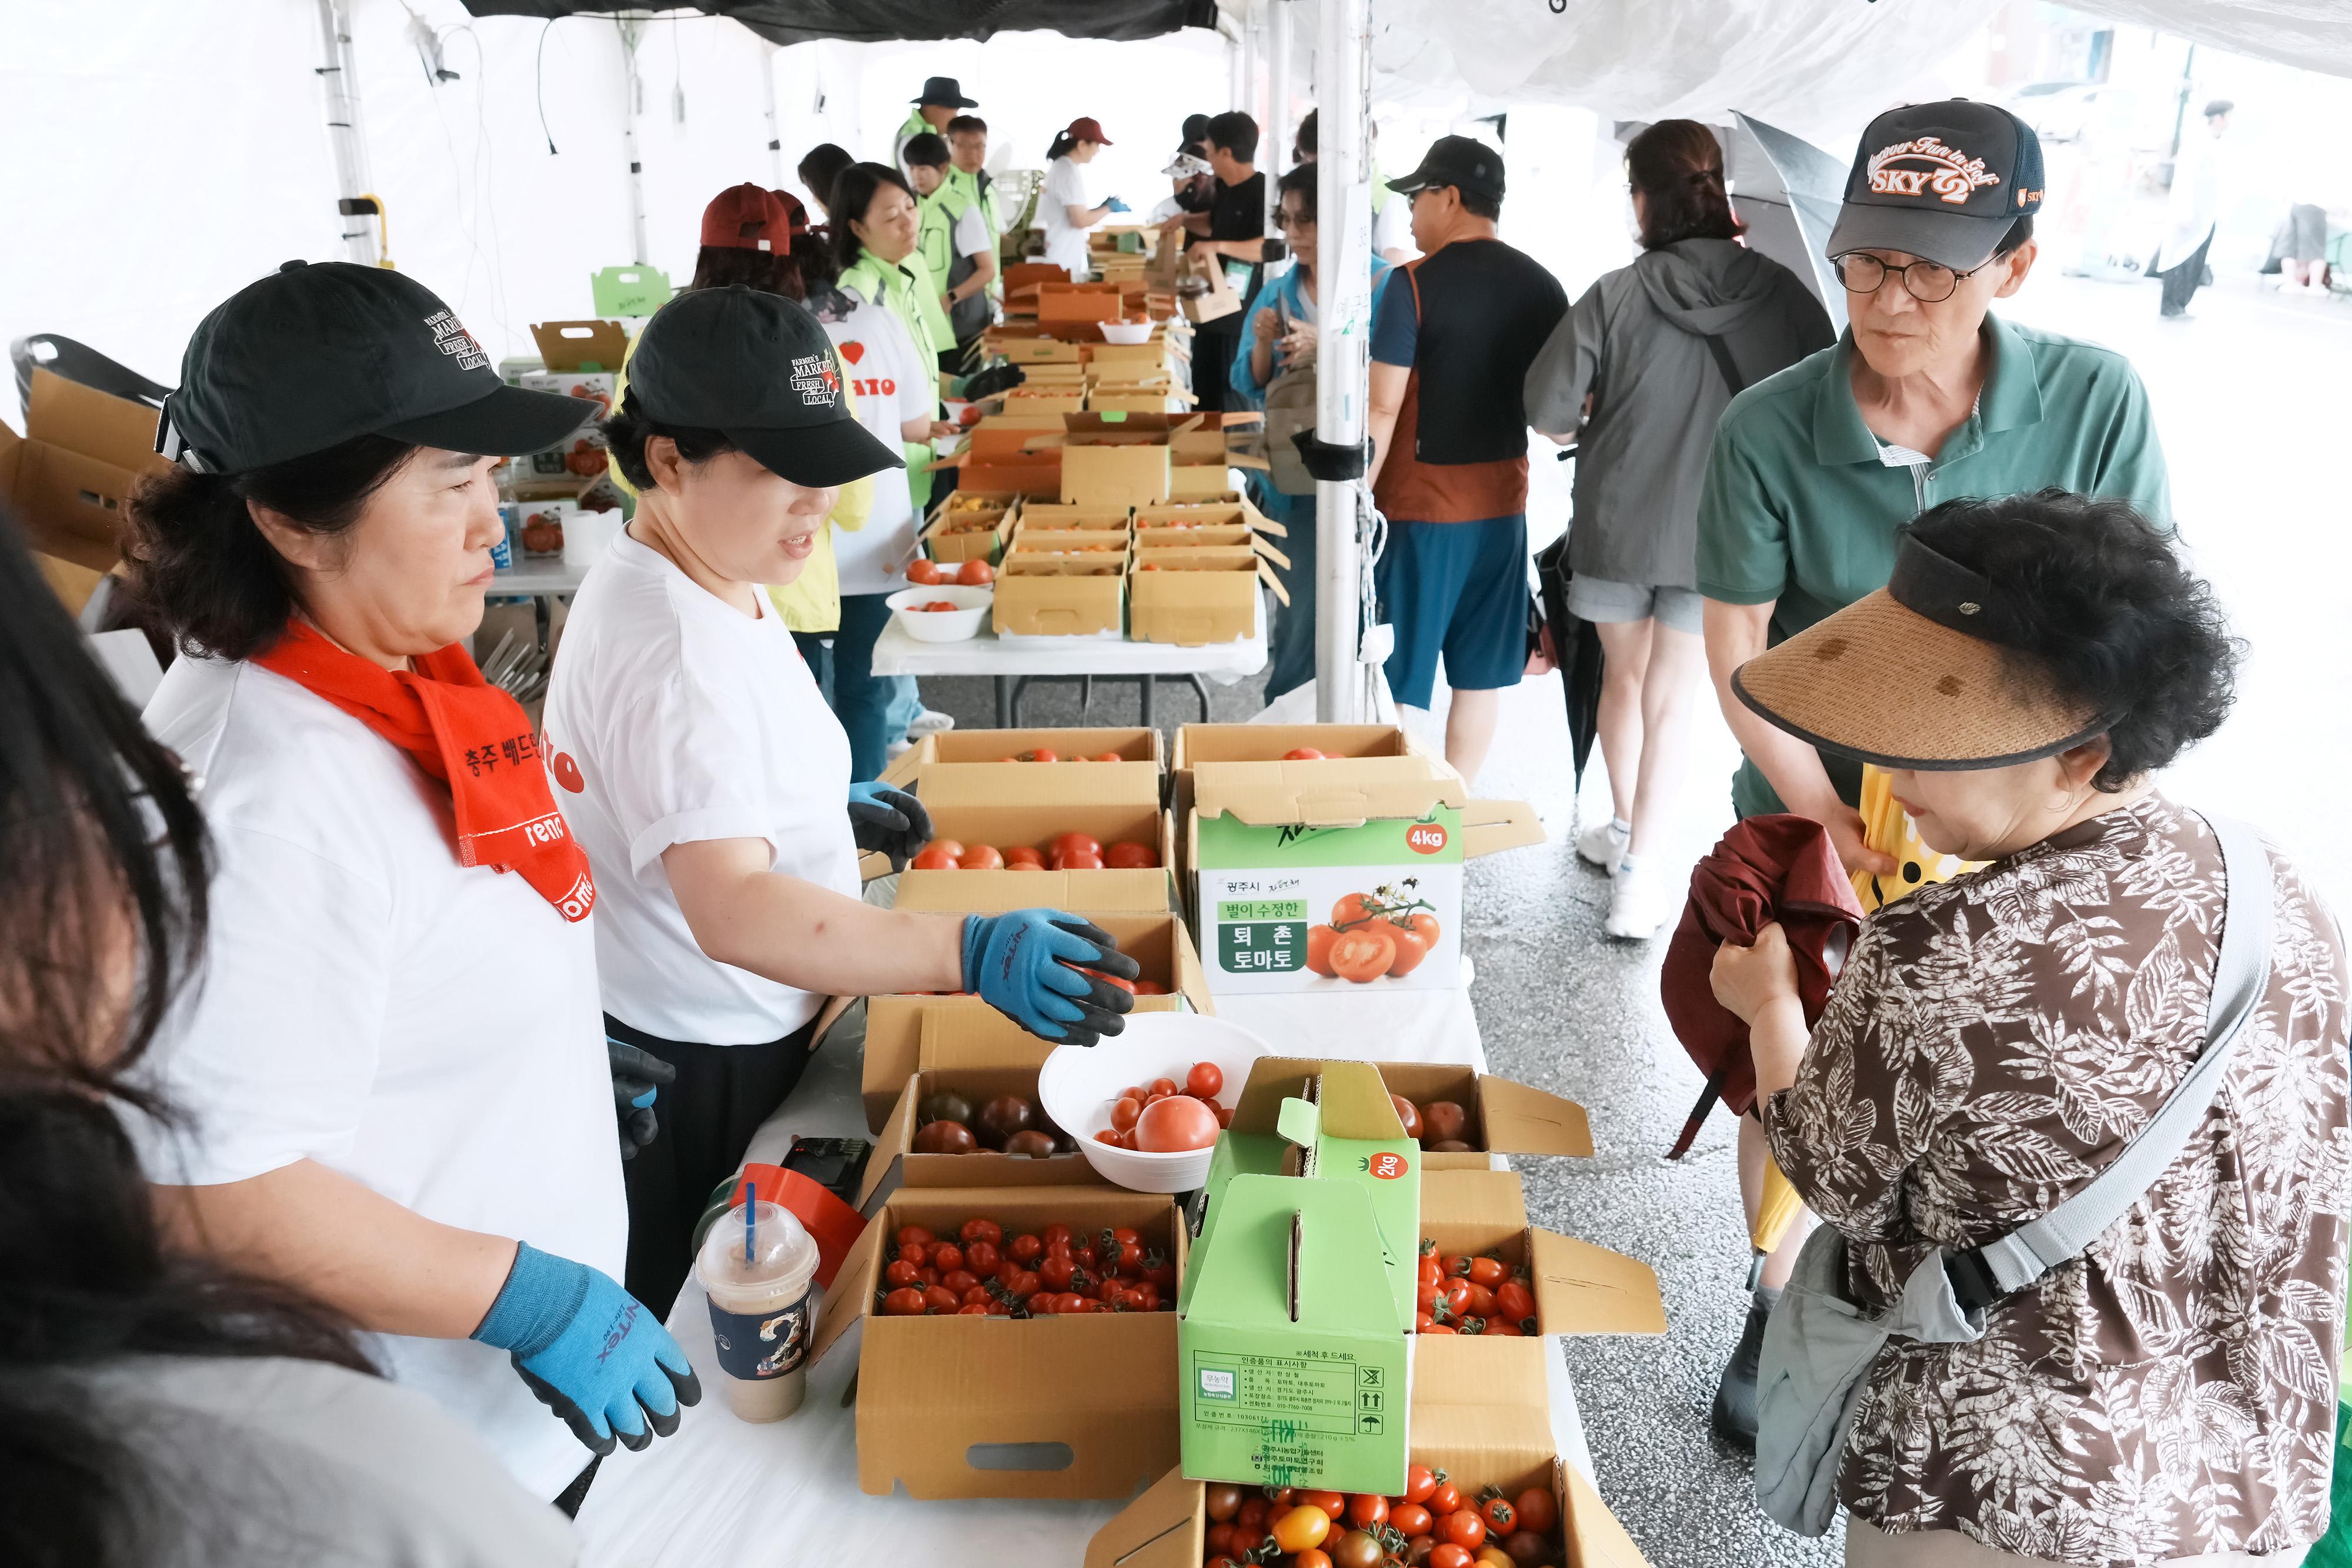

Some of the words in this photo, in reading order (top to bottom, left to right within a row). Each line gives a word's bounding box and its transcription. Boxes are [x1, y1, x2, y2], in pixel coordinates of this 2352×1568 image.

[1912, 136, 1952, 158] Fun
[1962, 158, 2000, 186] Golf
[443, 338, 468, 353] FRESH
[462, 354, 486, 369] LOCAL
[794, 360, 831, 377] MARKET
[796, 380, 820, 390] FRESH
[807, 394, 831, 404] LOCAL
[465, 743, 499, 777] 충주
[1411, 830, 1442, 847] 4kg
[1227, 881, 1259, 892] 광주시
[1227, 903, 1252, 918] 벌이
[1257, 902, 1299, 918] 수정한
[1233, 950, 1292, 970] 토마토
[1377, 1155, 1398, 1176] 2kg
[1241, 1356, 1272, 1366] 인증품의
[1277, 1360, 1307, 1369] 표시사항
[1321, 1351, 1329, 1359] 후
[1206, 1375, 1228, 1384] 무농약
[1277, 1403, 1313, 1412] 010-7760-7008
